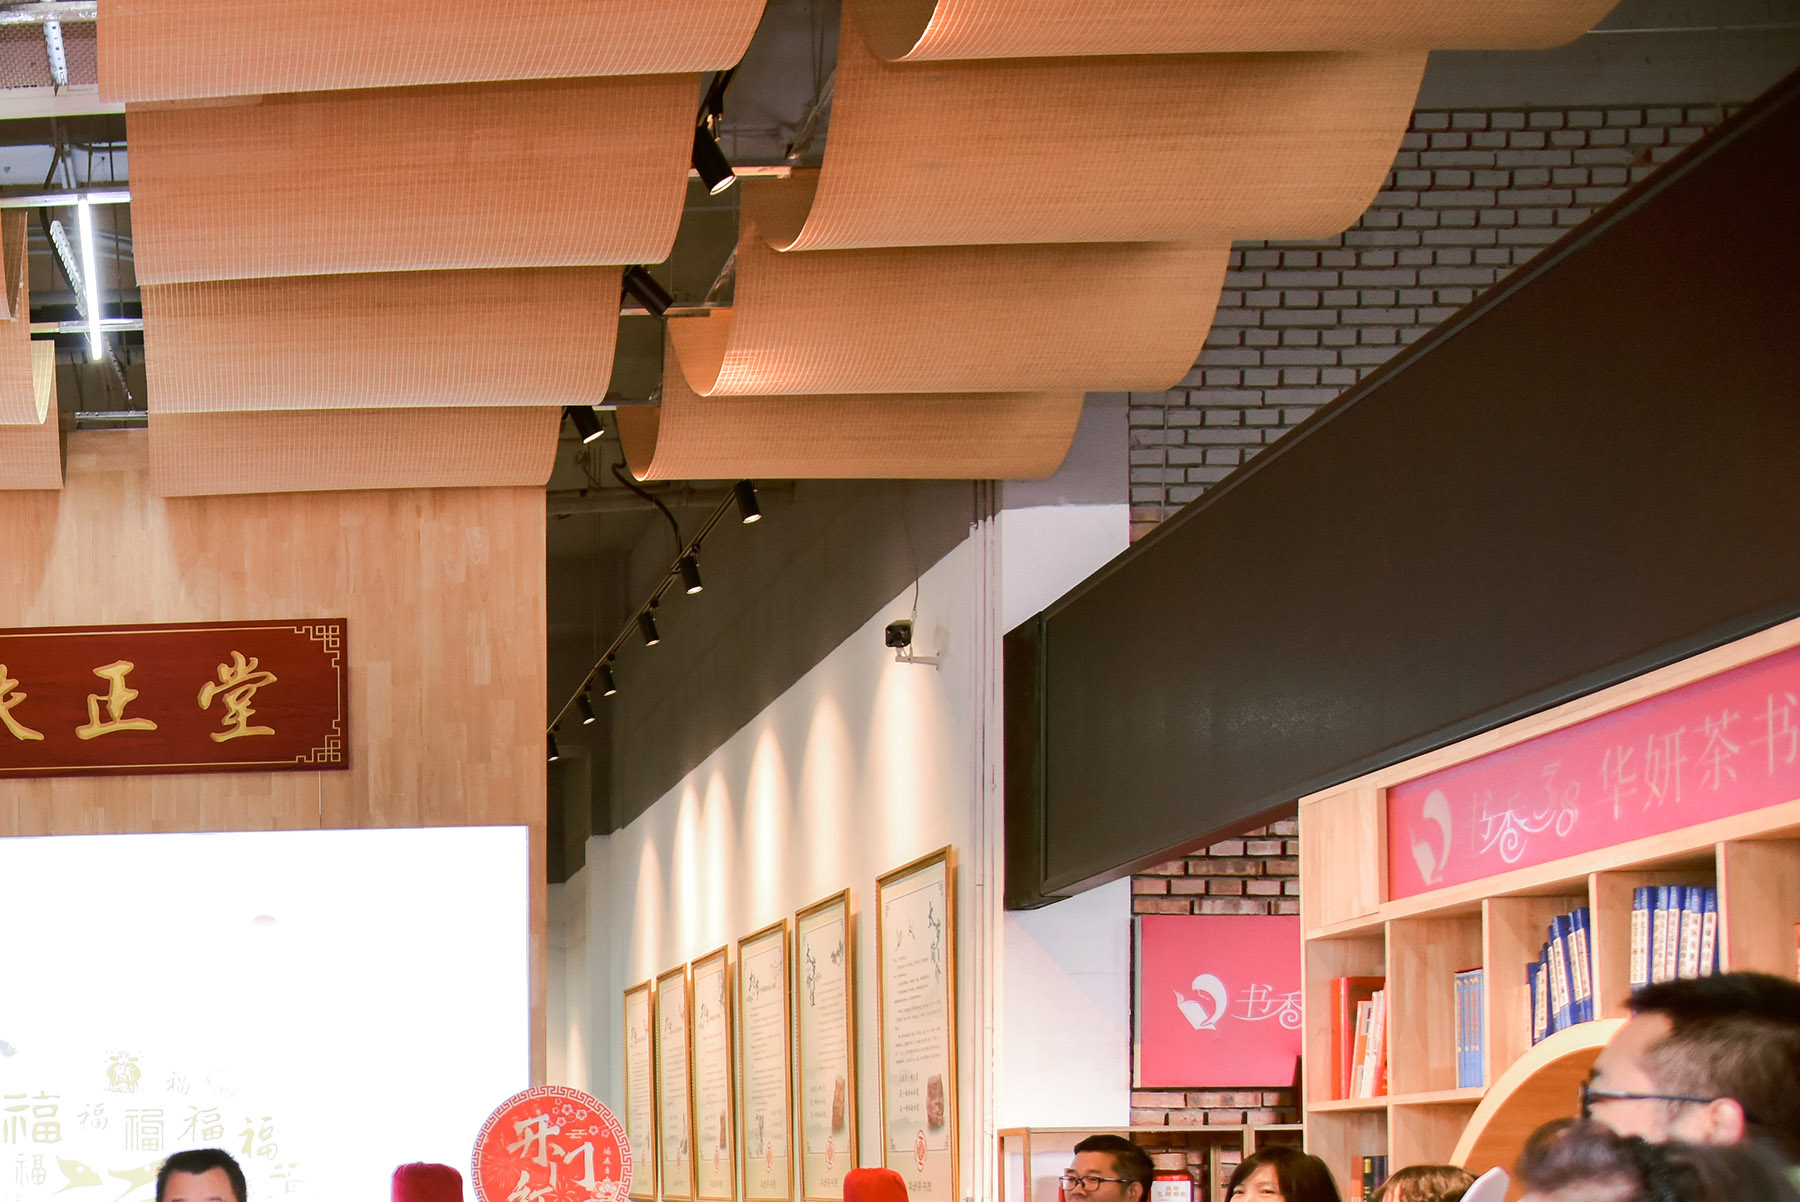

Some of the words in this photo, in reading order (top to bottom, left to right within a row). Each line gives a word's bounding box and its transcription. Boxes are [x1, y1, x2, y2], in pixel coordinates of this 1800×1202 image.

[1600, 692, 1799, 821] 华妍茶书
[3, 1090, 62, 1144] 福
[177, 1105, 225, 1143] 福
[238, 1116, 279, 1160] 福
